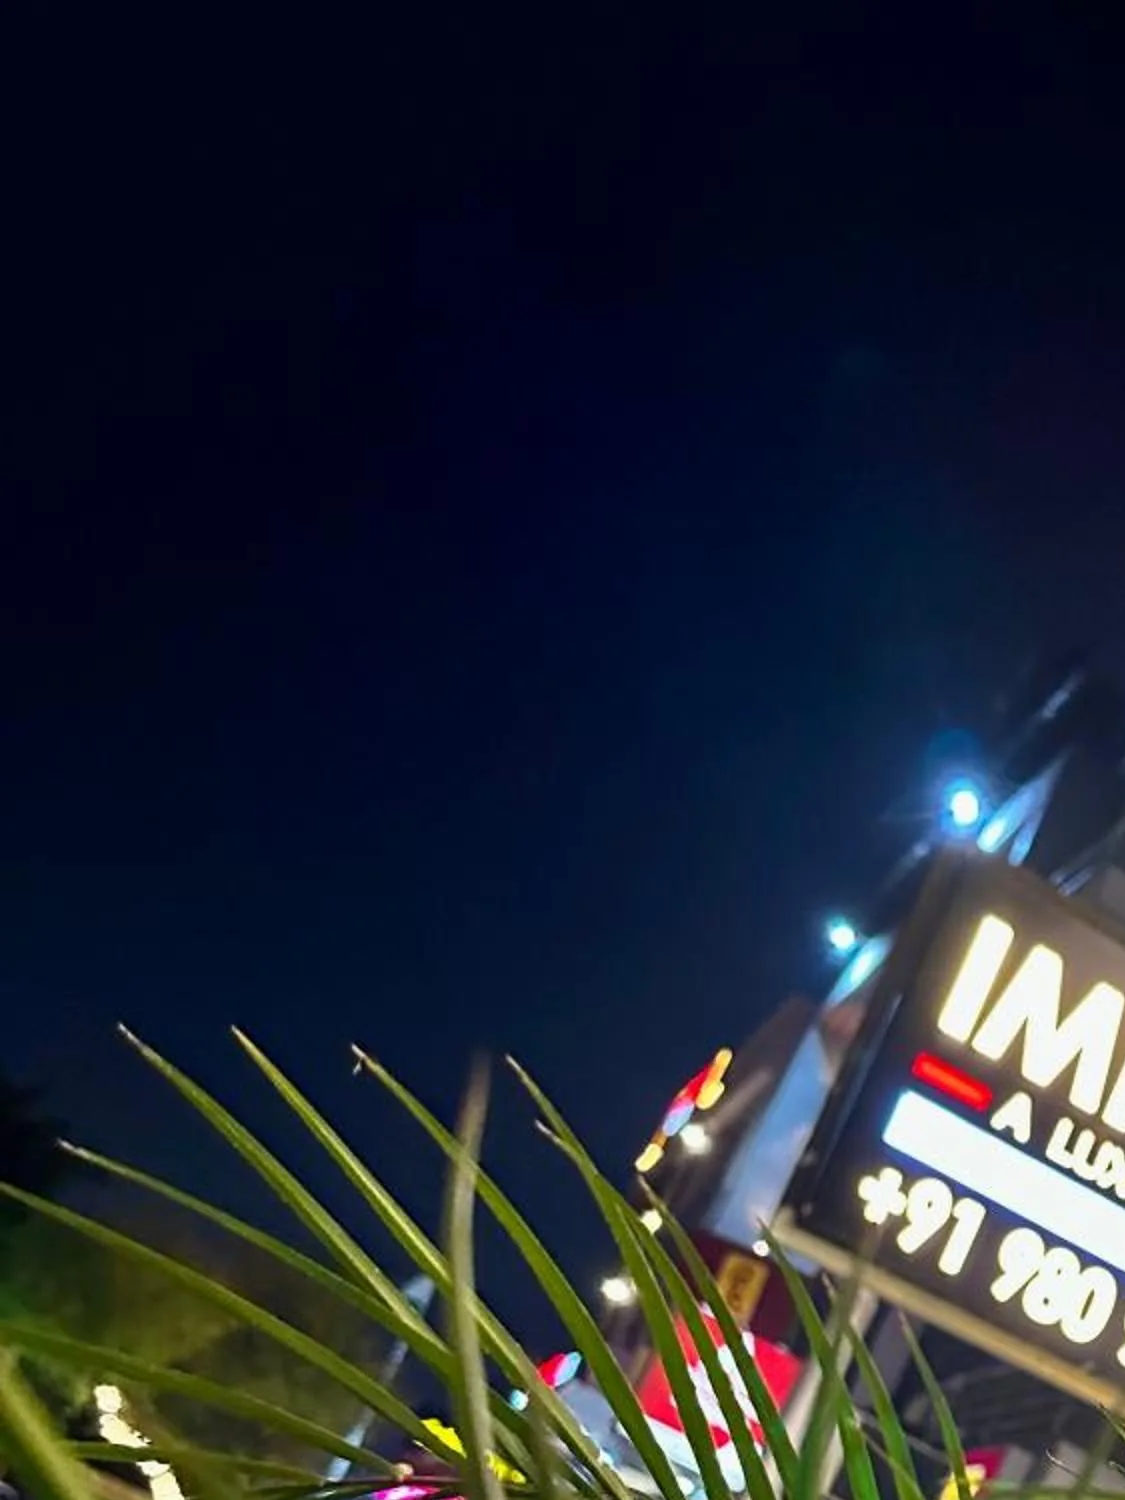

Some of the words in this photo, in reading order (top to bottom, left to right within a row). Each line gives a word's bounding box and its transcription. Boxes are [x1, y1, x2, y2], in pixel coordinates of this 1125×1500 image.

[989, 1092, 1033, 1144] A
[857, 1166, 988, 1276] +91
[989, 1227, 1118, 1344] 980
